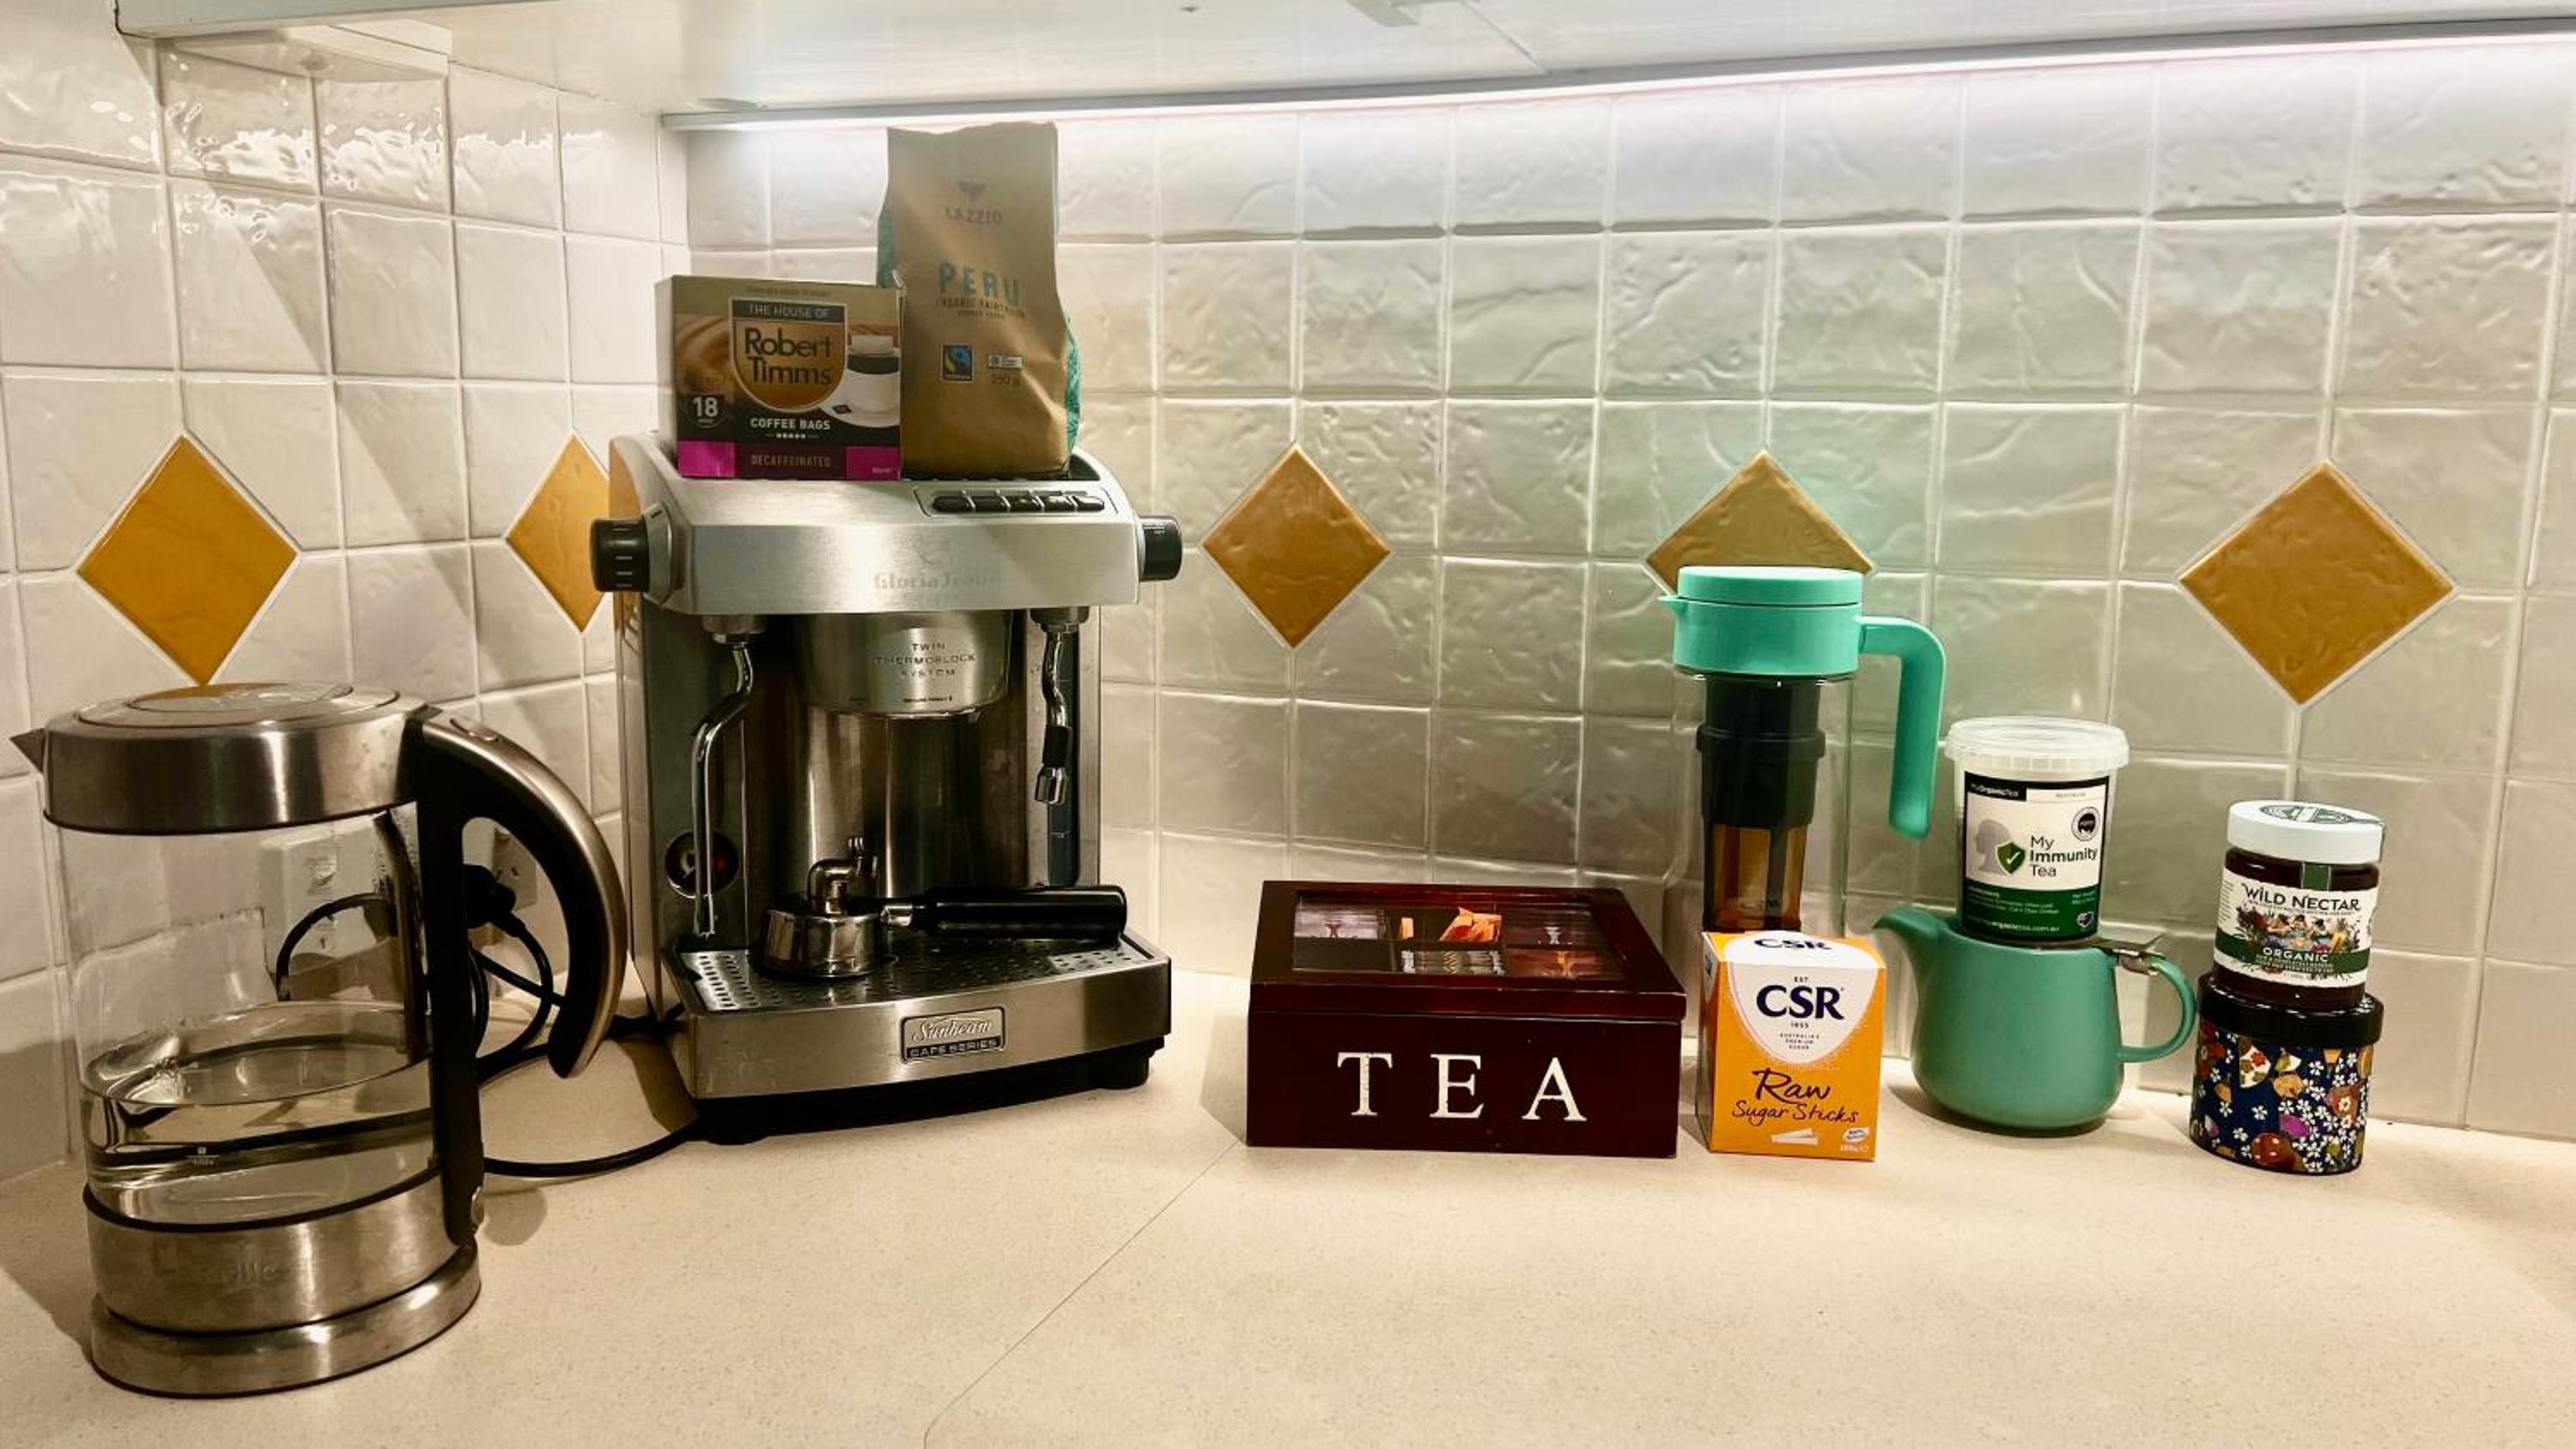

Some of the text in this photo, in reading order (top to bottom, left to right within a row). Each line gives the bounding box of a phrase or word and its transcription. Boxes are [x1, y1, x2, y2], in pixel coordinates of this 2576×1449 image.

[939, 262, 1019, 305] PERU
[749, 304, 829, 318] THE HOUSE OF
[744, 327, 831, 357] Robert
[747, 355, 833, 385] Timms
[693, 397, 718, 417] 18
[750, 417, 831, 430] COFFEE BAGS
[750, 453, 832, 468] DECAFFEINATED
[872, 571, 939, 590] Gloria
[912, 641, 945, 652] TWIN
[2031, 834, 2055, 852] My
[2030, 846, 2099, 863] Immunity
[2030, 863, 2057, 877] Tea
[2241, 882, 2287, 906] WILD
[2292, 894, 2362, 912] NECTAR
[1754, 938, 1832, 950] CSR
[2262, 947, 2330, 962] ORGANIC
[1756, 985, 1845, 1021] CSR
[911, 1017, 993, 1042] Sunbeam
[949, 1038, 998, 1052] SERIES
[1751, 1067, 1832, 1105] Raw
[1732, 1100, 1860, 1126] Sugar Sticks
